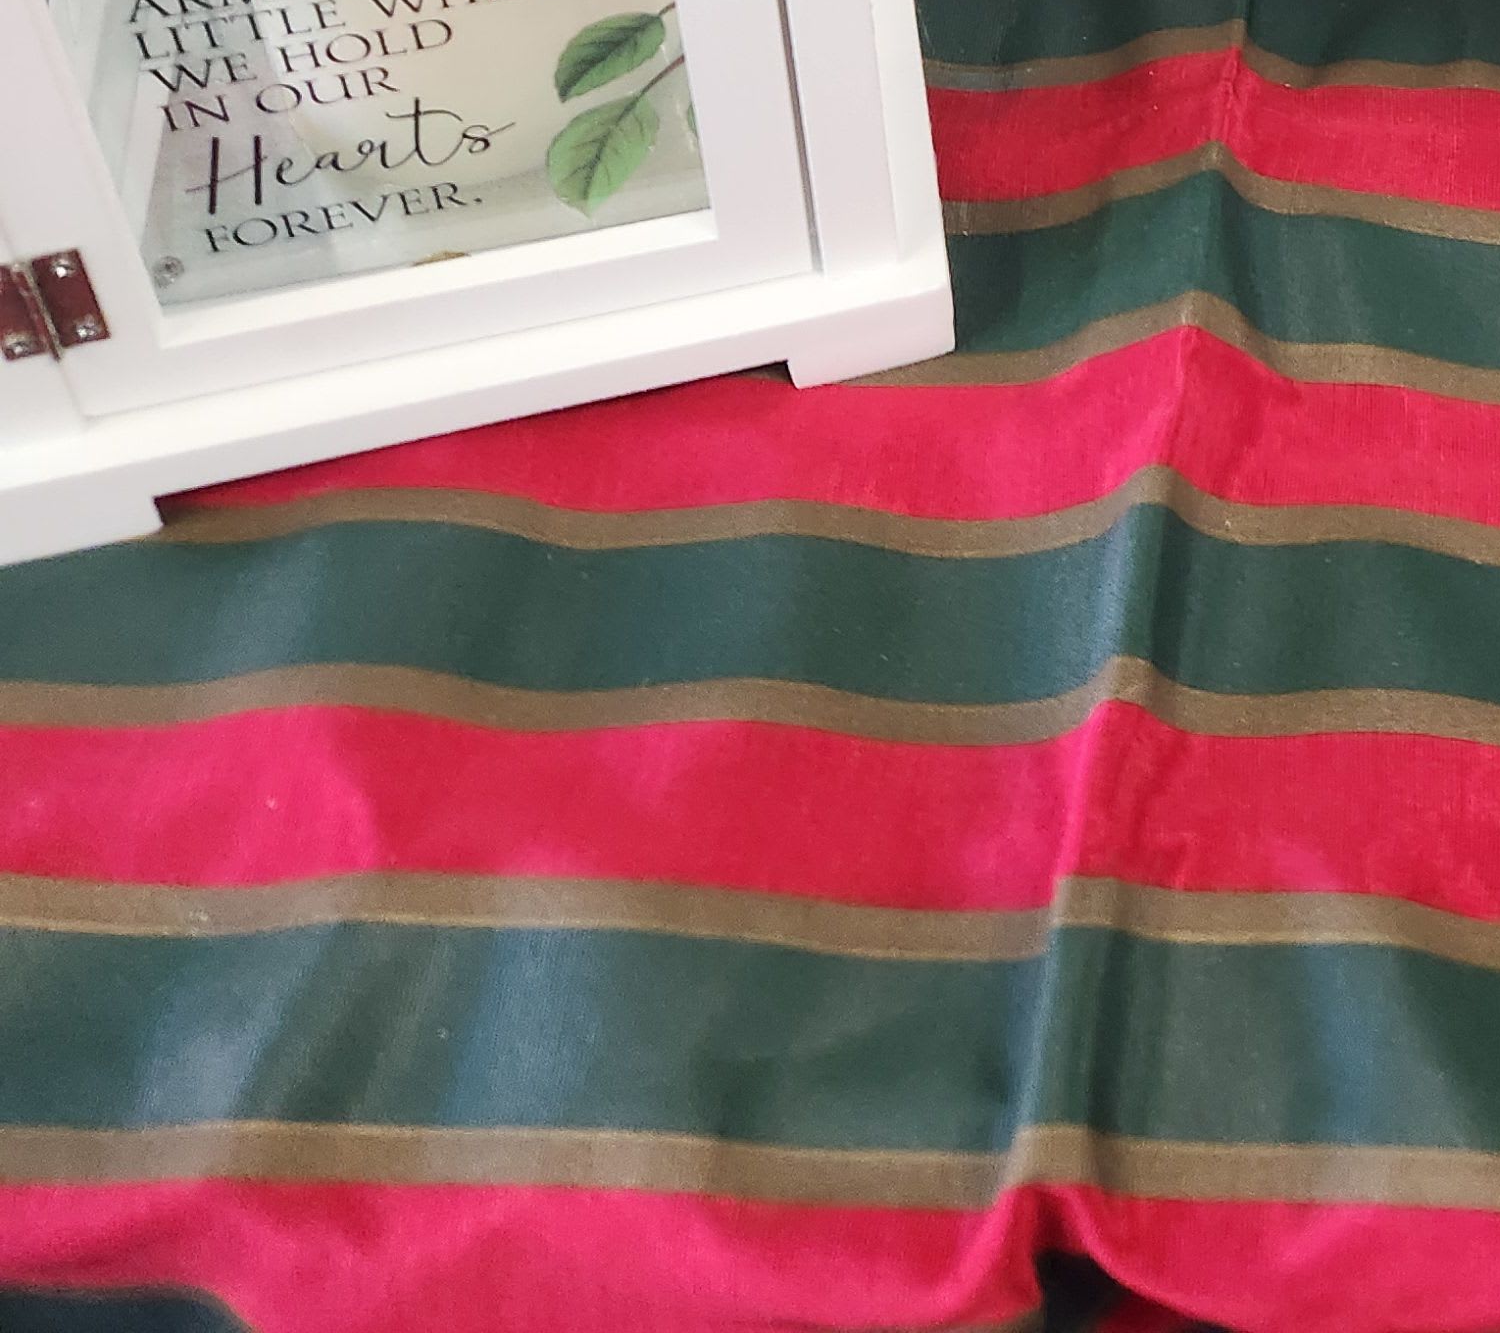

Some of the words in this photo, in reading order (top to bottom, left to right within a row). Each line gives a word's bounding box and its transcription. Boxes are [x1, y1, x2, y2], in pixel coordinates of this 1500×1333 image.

[133, 0, 347, 61] LITTLE
[146, 52, 259, 95] WE
[278, 18, 454, 74] HOLD
[159, 96, 231, 134] IN
[256, 66, 402, 117] OUR
[185, 97, 516, 215] Hearts
[202, 181, 484, 254] FOREVER.
